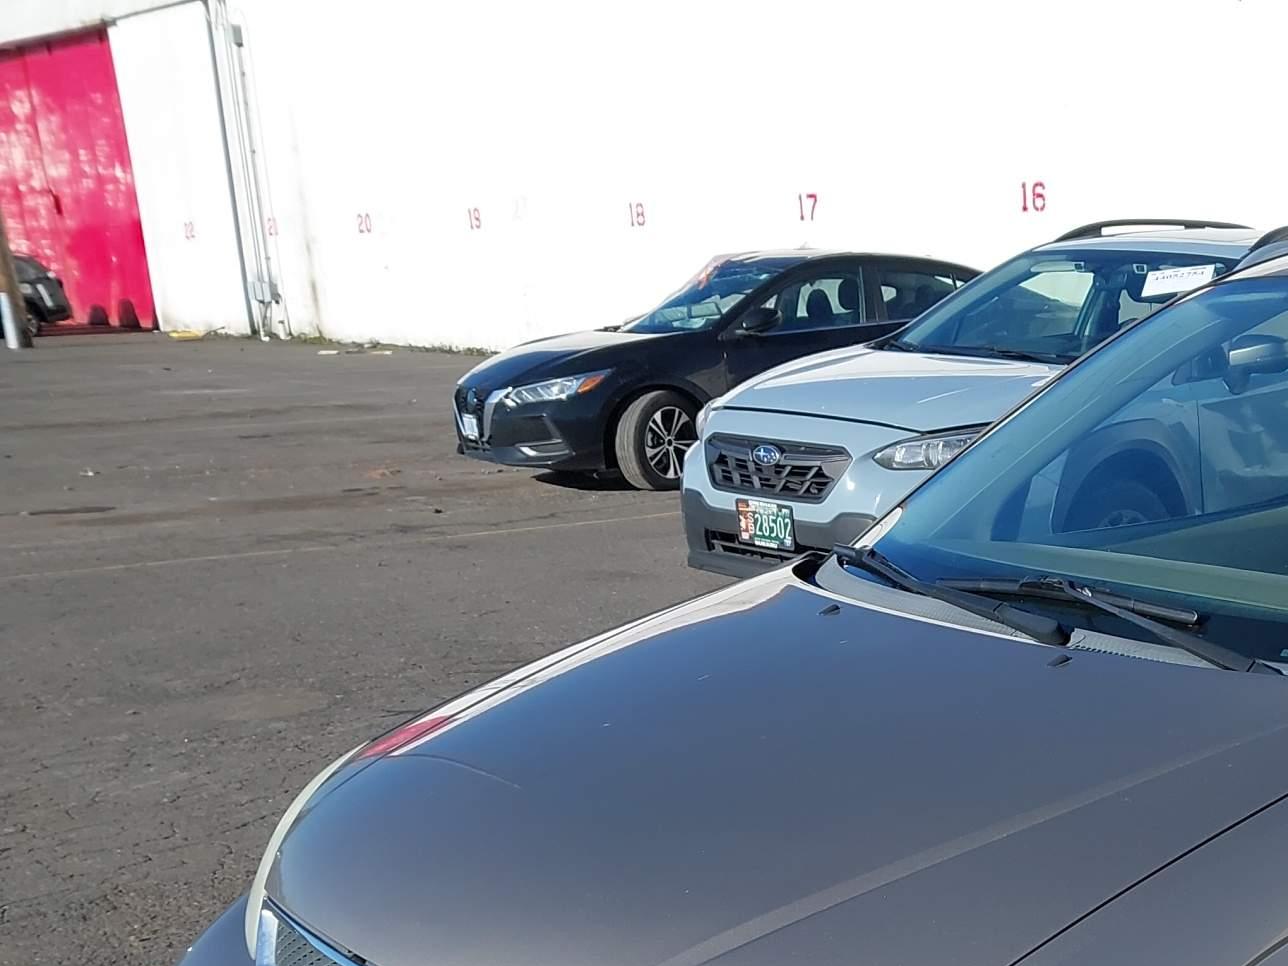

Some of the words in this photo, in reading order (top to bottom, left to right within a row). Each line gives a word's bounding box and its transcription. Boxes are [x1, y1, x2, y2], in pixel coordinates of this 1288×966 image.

[798, 192, 818, 222] 17
[1021, 181, 1046, 213] 16
[357, 212, 372, 235] 20
[467, 207, 482, 230] 19
[628, 202, 646, 228] 18
[755, 514, 792, 539] 28502
